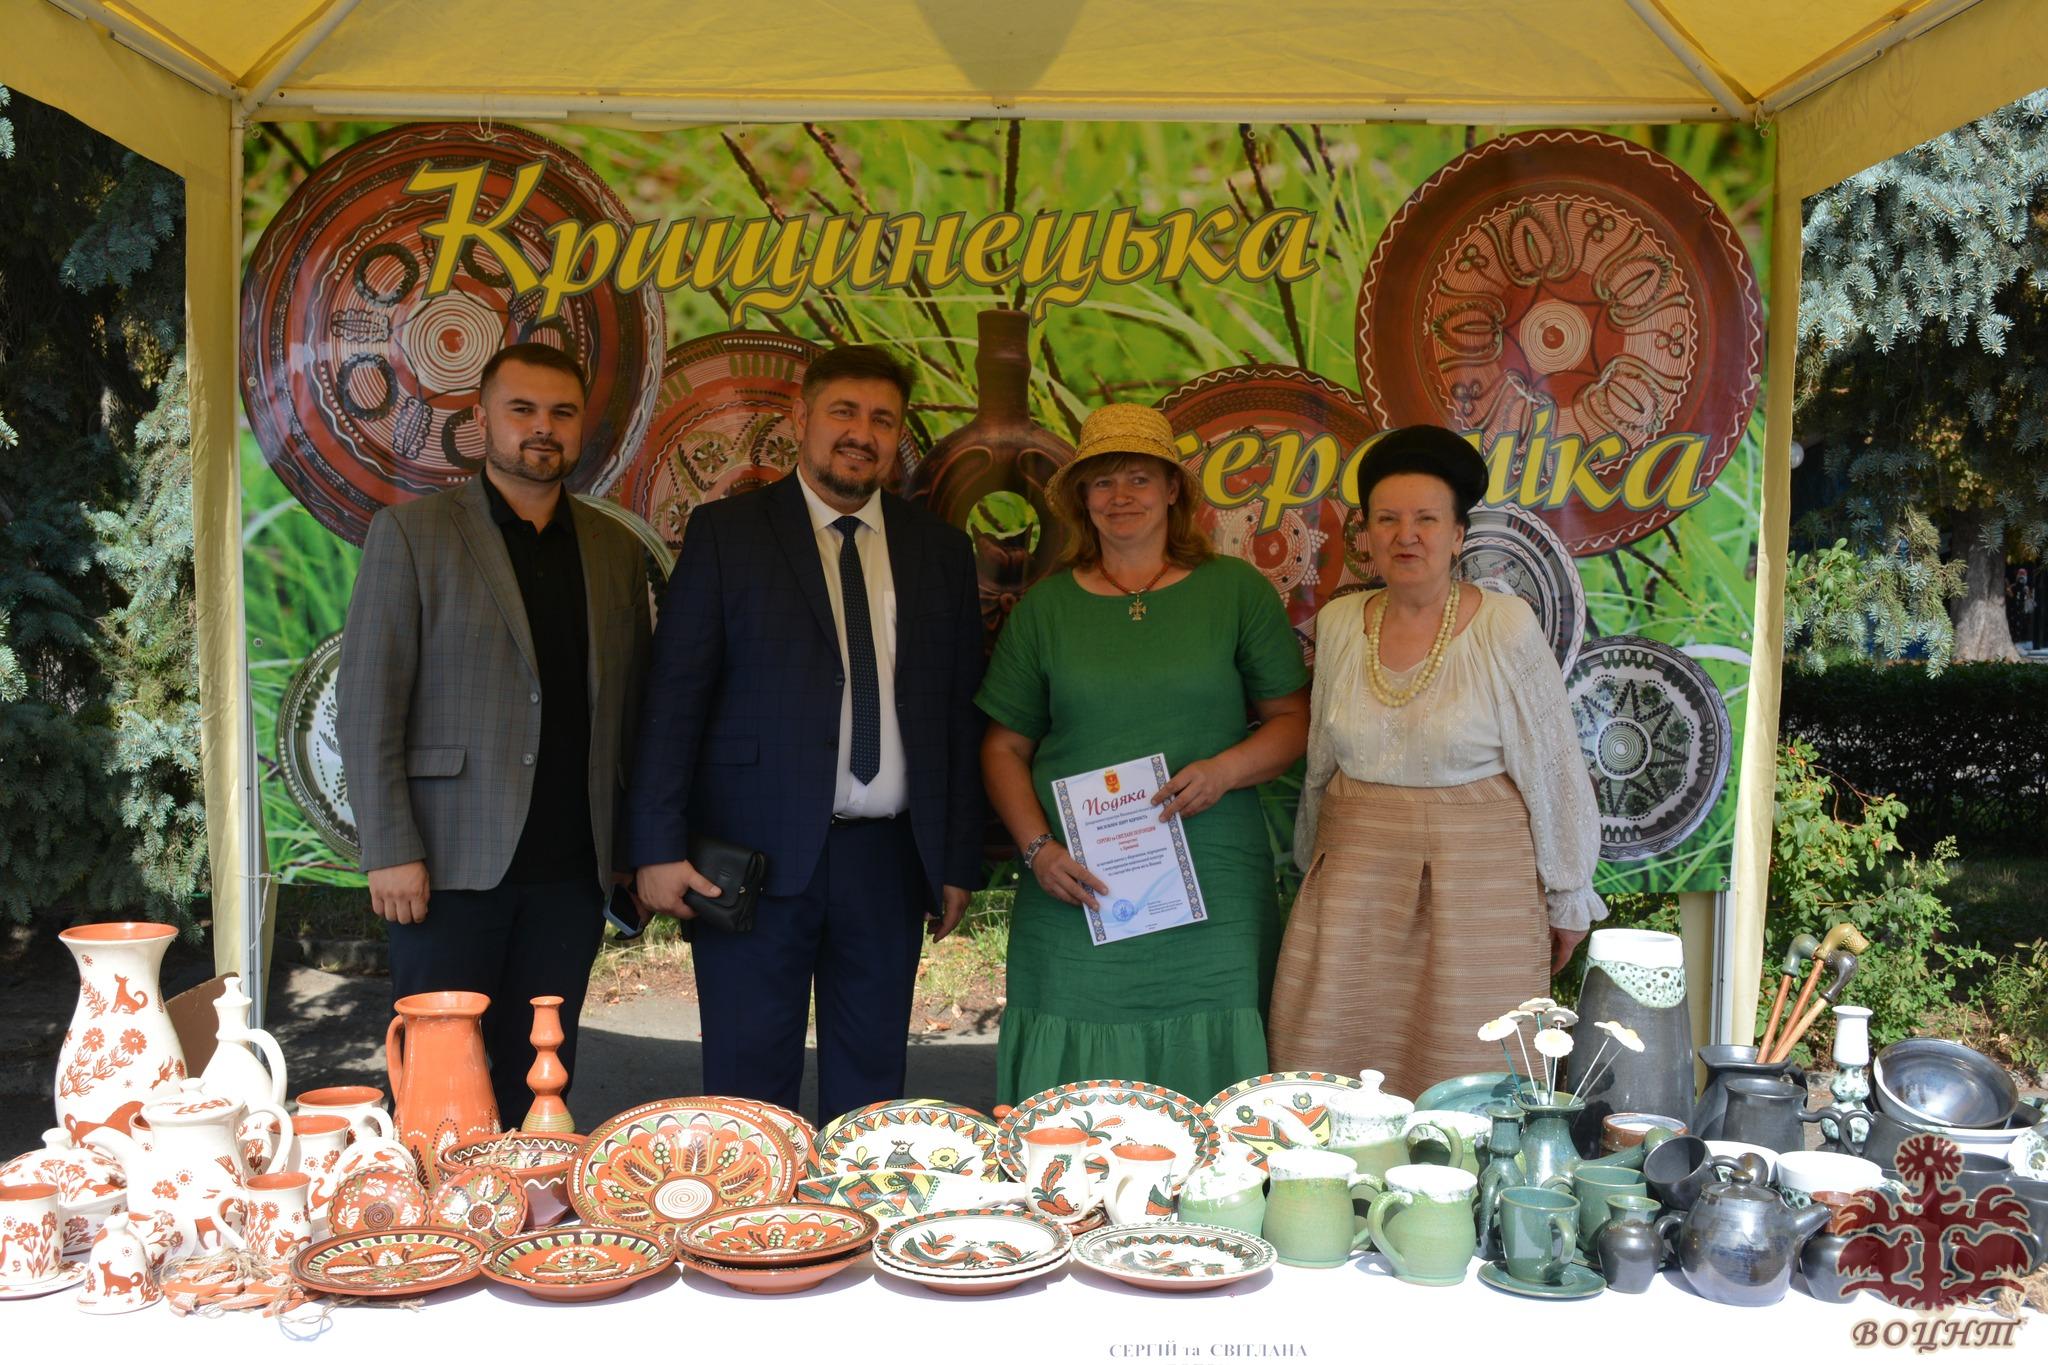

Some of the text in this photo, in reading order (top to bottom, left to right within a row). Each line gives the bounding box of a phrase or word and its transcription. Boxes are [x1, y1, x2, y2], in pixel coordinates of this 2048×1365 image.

[402, 158, 1321, 330] Крищинецька
[1082, 789, 1146, 816] Подяка
[1109, 1340, 1308, 1357] СЕРГІЙ та СВІТЛАНА
